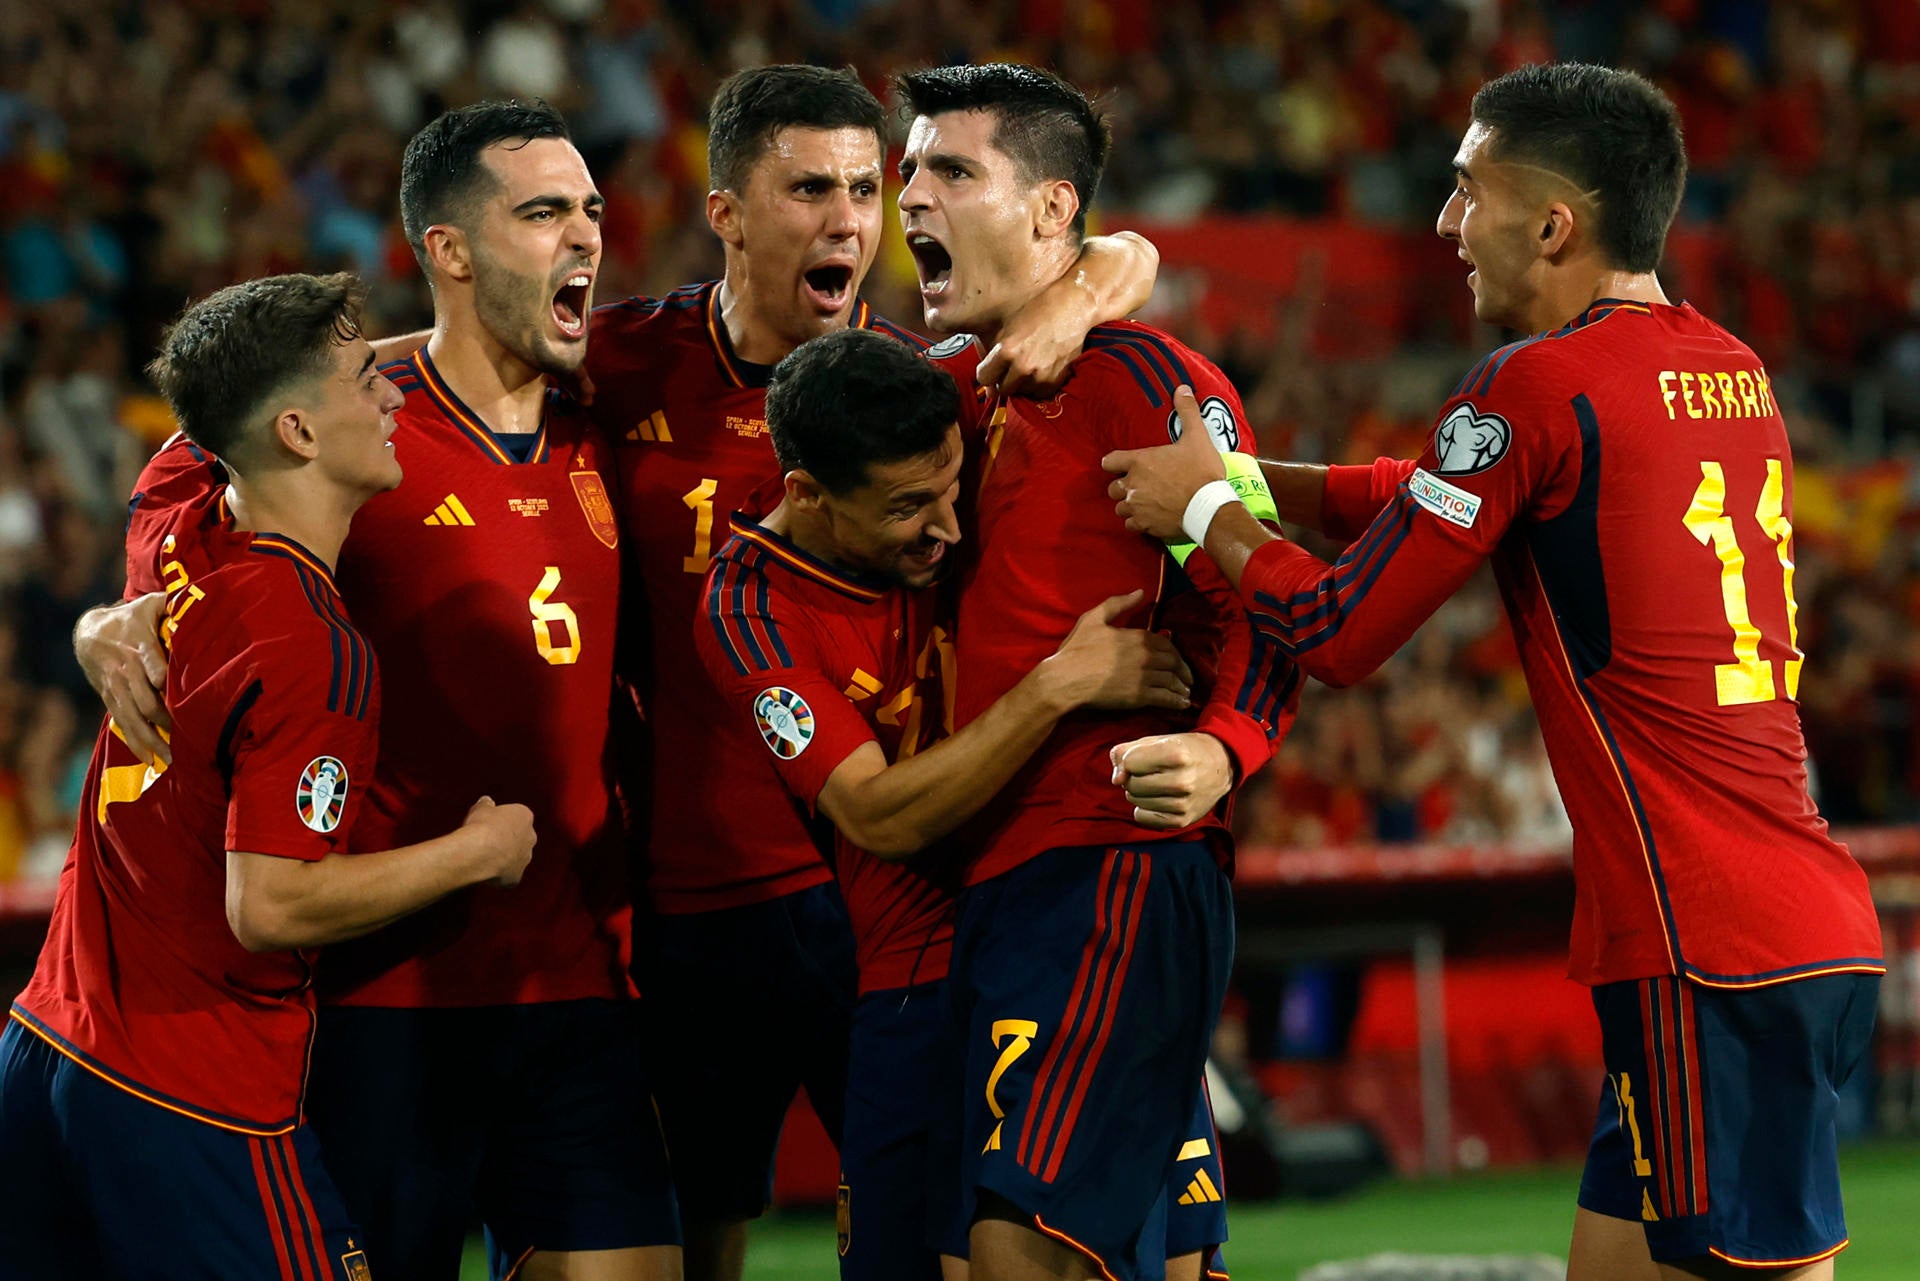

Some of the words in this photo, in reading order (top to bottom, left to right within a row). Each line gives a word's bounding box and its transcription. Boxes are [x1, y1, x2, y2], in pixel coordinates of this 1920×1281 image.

[1658, 366, 1774, 420] FERRAN
[1410, 478, 1476, 518] FOUNDATION
[529, 566, 581, 665] 6
[1682, 459, 1805, 706] 11
[985, 1018, 1038, 1119] 7
